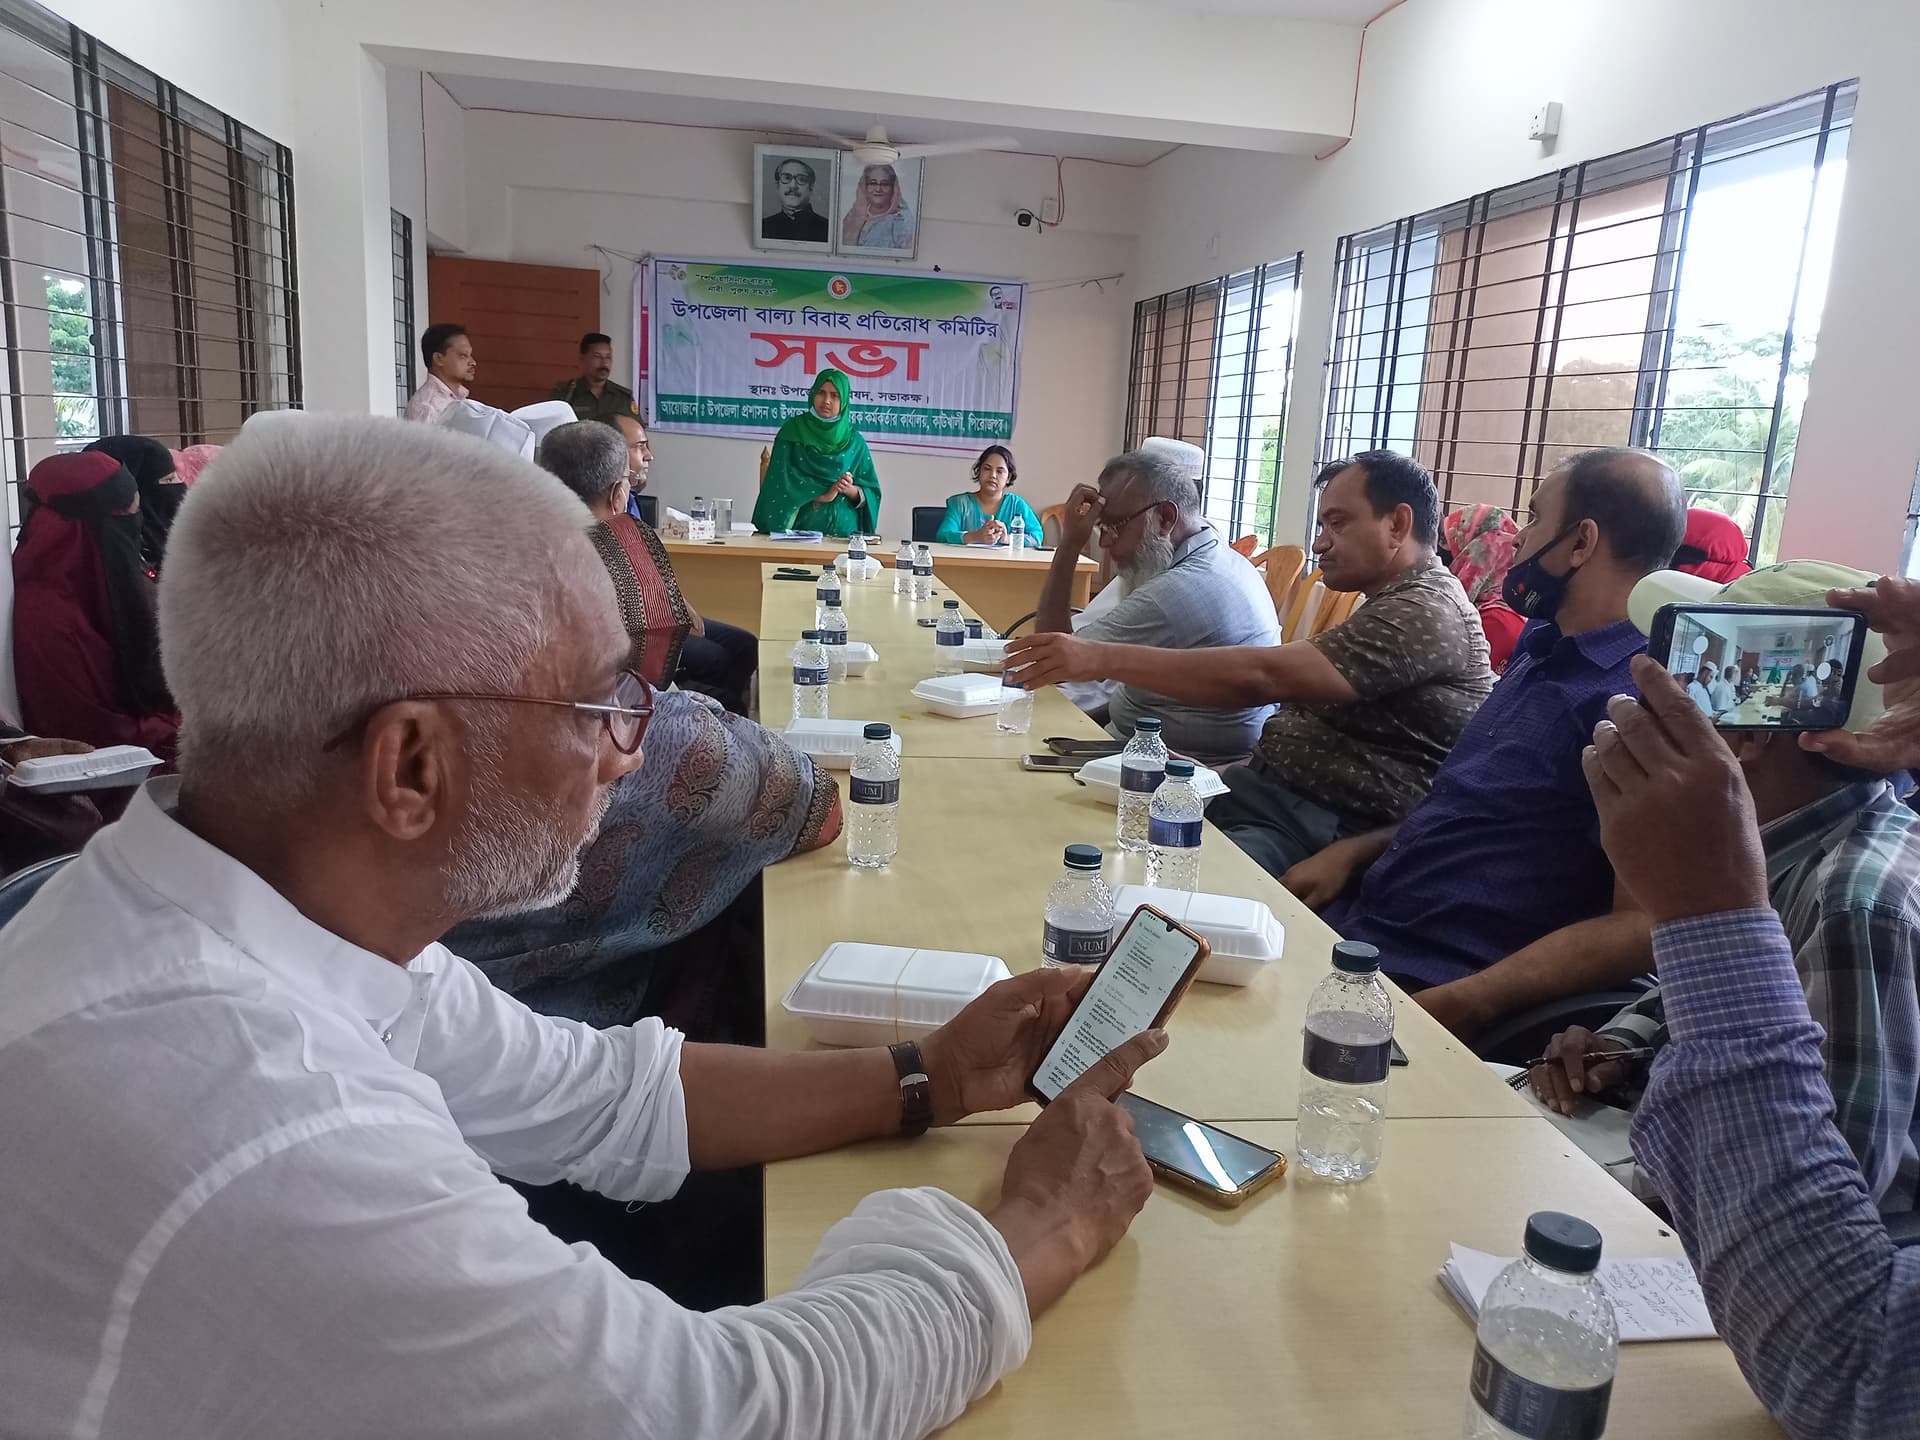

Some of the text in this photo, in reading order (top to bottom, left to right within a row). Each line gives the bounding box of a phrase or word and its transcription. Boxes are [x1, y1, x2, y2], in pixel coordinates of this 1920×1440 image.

[670, 298, 999, 338] উপজেলা বাল্য বিবাহ প্রতিরোধ কমিটির
[750, 332, 930, 381] সভা
[706, 400, 740, 418] উপজেলা
[1077, 940, 1104, 952] MUM
